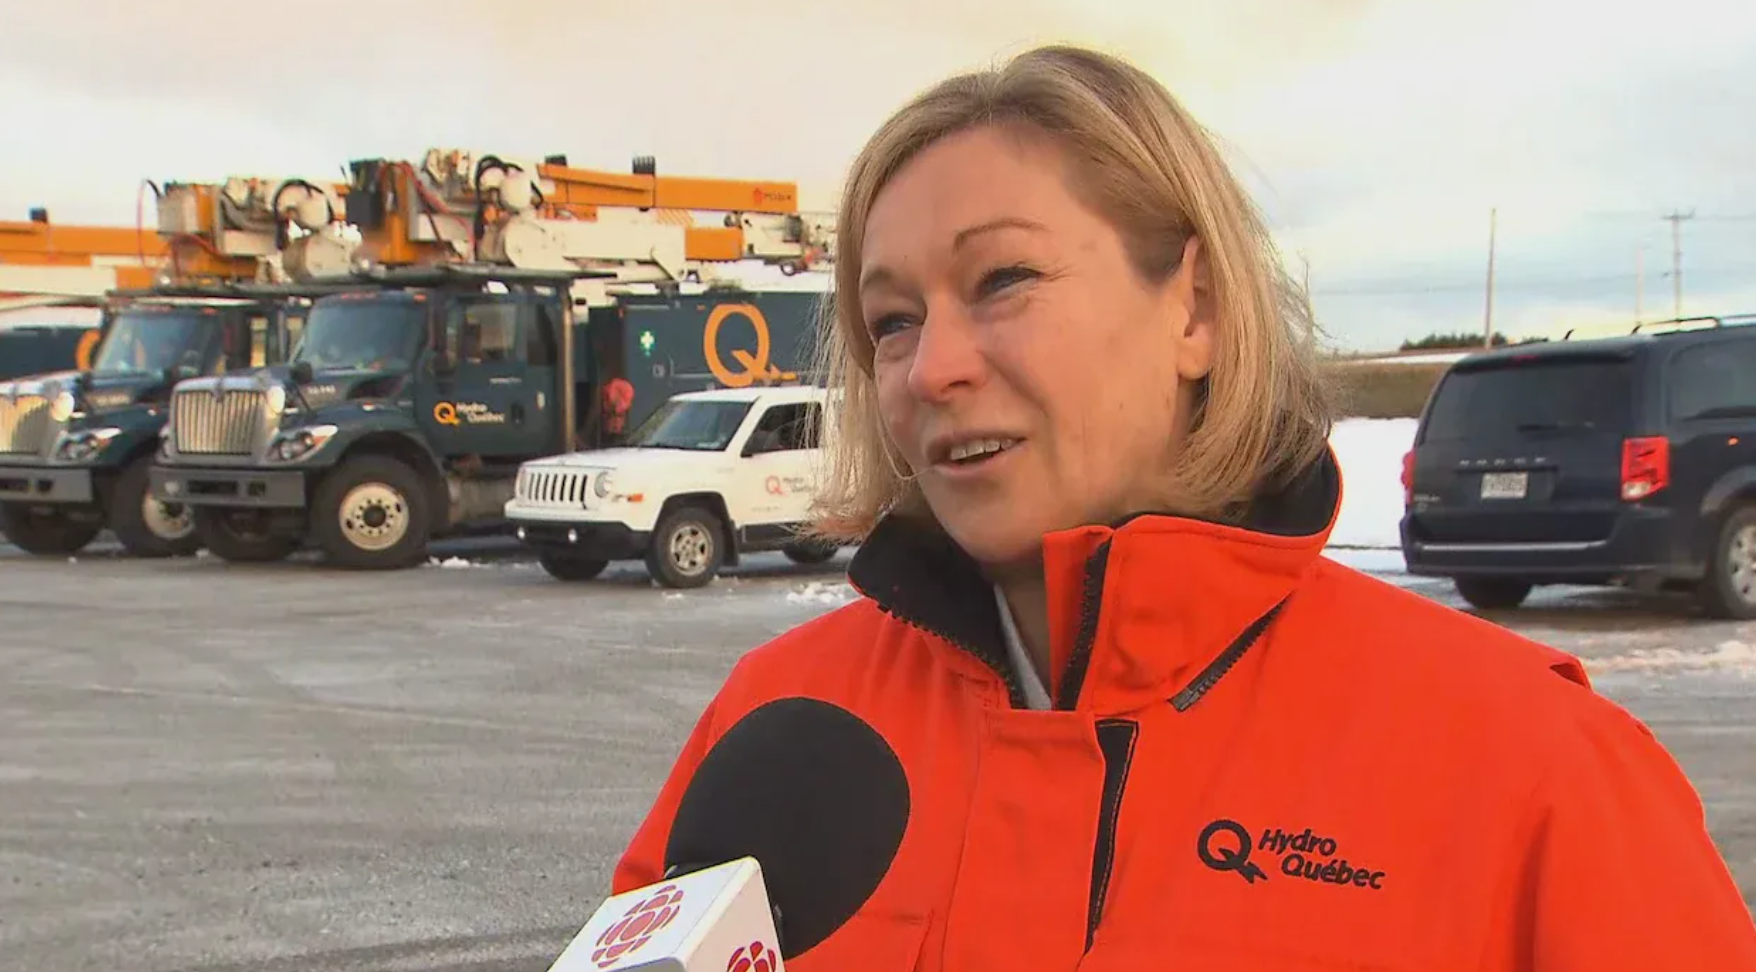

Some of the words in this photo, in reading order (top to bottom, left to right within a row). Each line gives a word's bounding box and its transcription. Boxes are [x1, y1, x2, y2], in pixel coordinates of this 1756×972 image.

[703, 304, 796, 387] Q
[433, 402, 459, 425] Q
[1197, 820, 1268, 884] Q
[1258, 829, 1336, 856] Hydro
[1281, 853, 1386, 889] Québec
